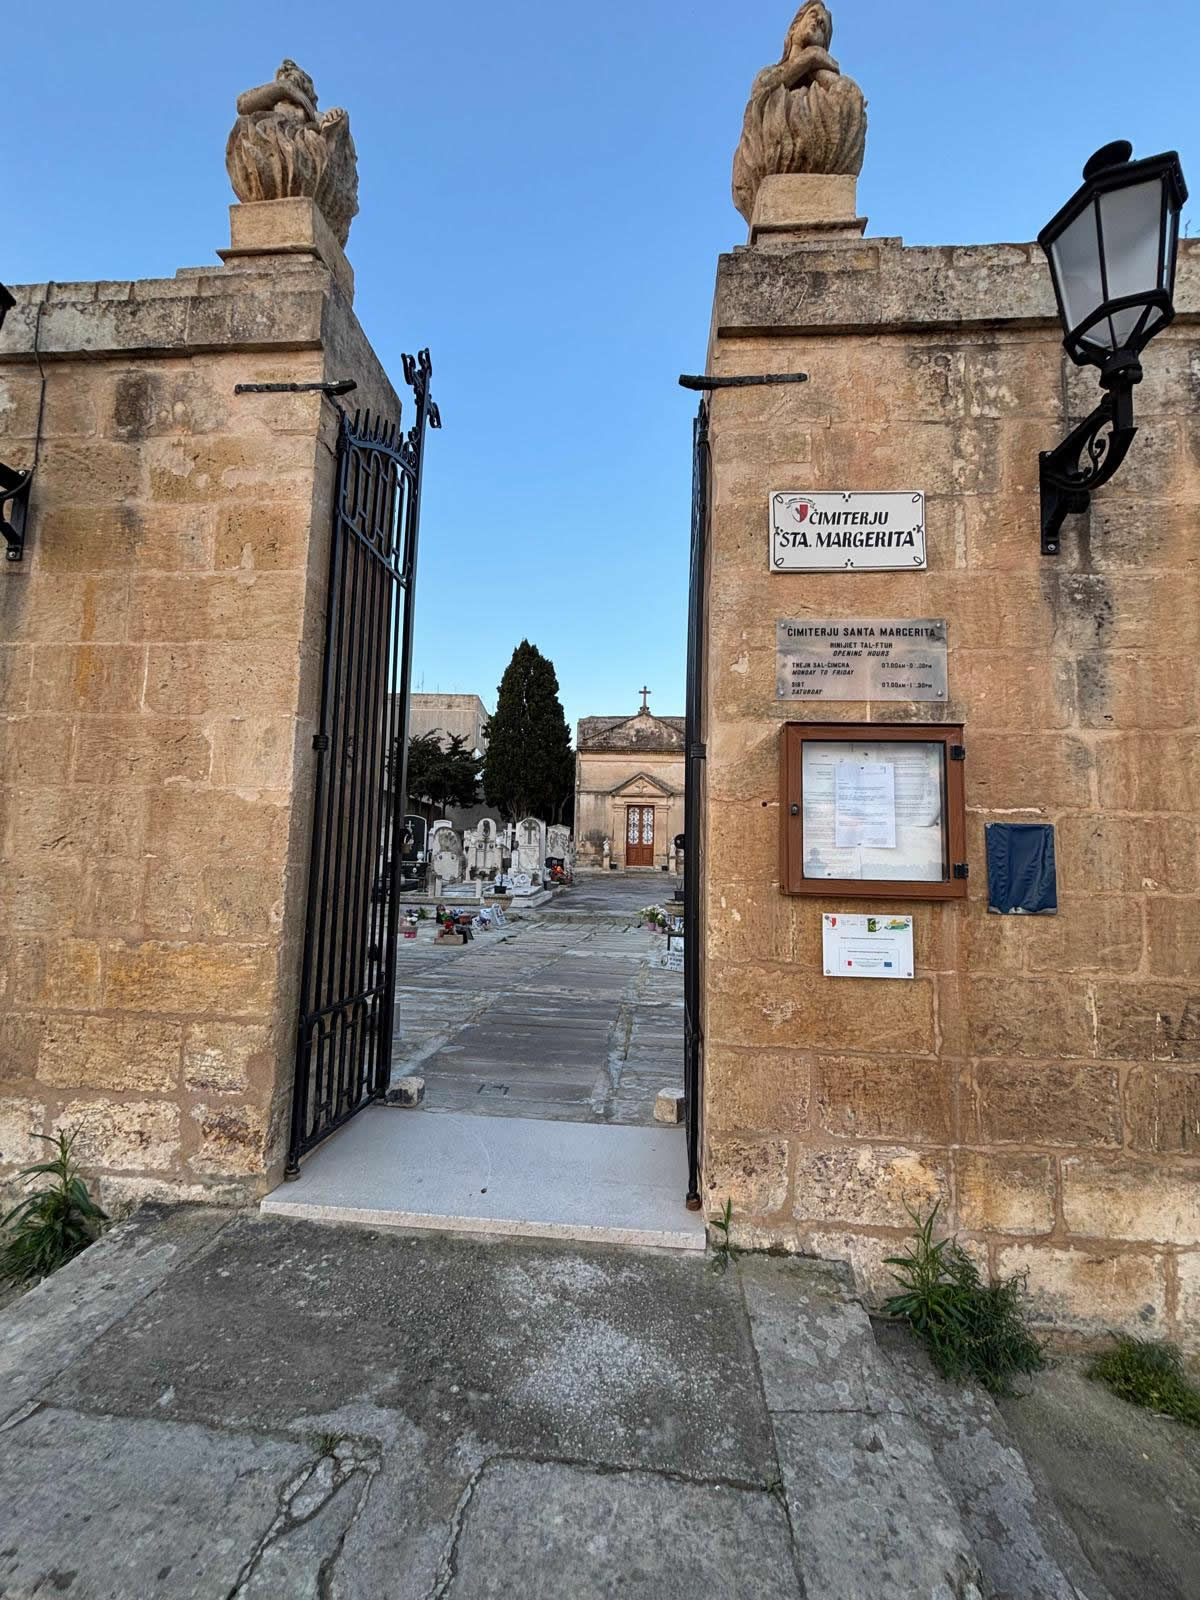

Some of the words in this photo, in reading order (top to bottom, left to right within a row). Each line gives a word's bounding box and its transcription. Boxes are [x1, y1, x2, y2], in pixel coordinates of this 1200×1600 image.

[779, 532, 812, 548] STA.
[816, 530, 915, 548] MARGERITA
[843, 627, 875, 637] SANTA
[791, 688, 824, 696] SATURDAY
